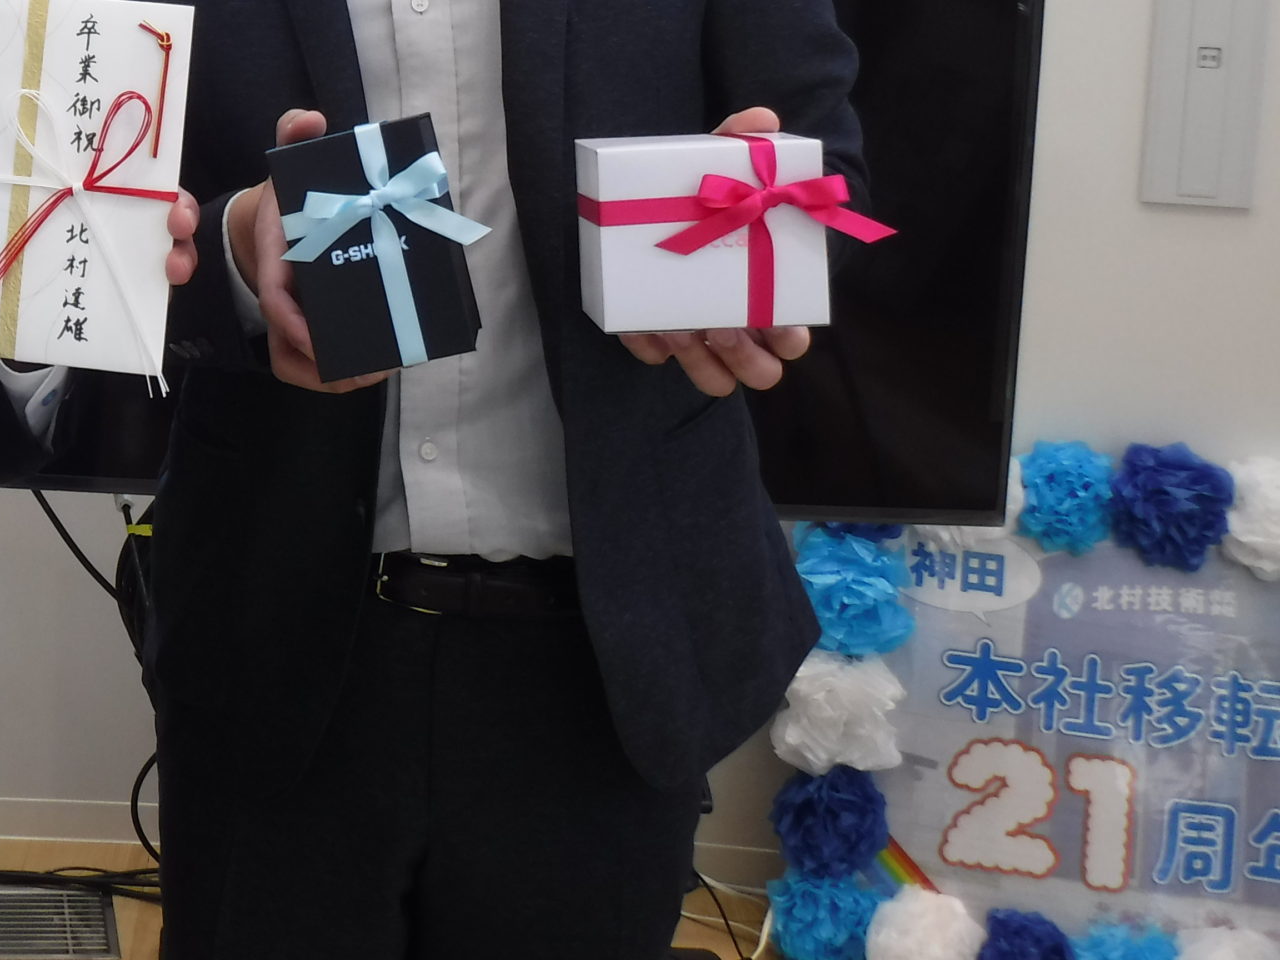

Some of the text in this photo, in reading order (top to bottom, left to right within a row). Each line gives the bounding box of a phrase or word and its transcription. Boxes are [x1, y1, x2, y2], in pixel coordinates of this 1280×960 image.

[65, 13, 103, 153] 卒業御祝
[330, 234, 410, 266] G-SHK
[909, 541, 1005, 597] 神田
[941, 638, 1280, 761] 本社移転
